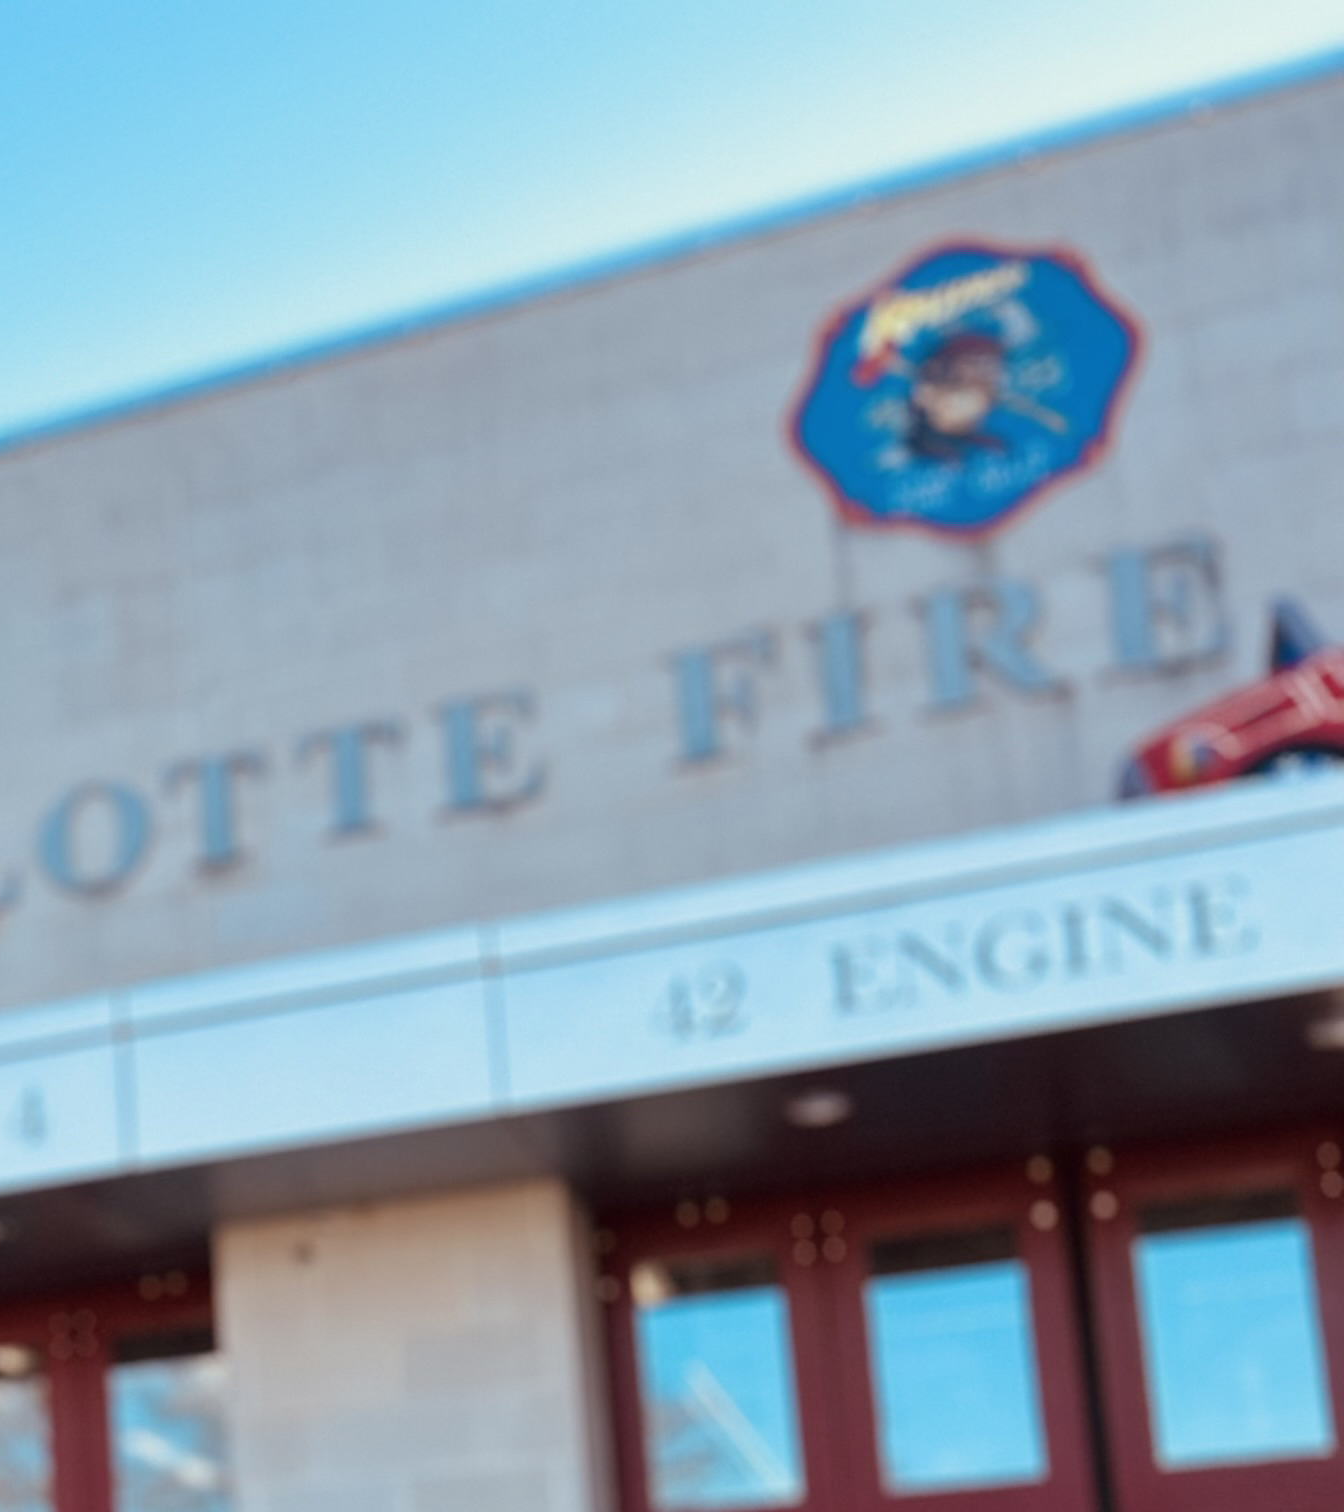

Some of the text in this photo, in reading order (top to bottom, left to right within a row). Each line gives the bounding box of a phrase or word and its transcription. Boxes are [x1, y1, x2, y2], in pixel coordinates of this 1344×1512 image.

[660, 530, 1237, 772] FIRE
[654, 873, 1264, 1043] 42 ENGINE
[1, 1082, 51, 1148] 4
